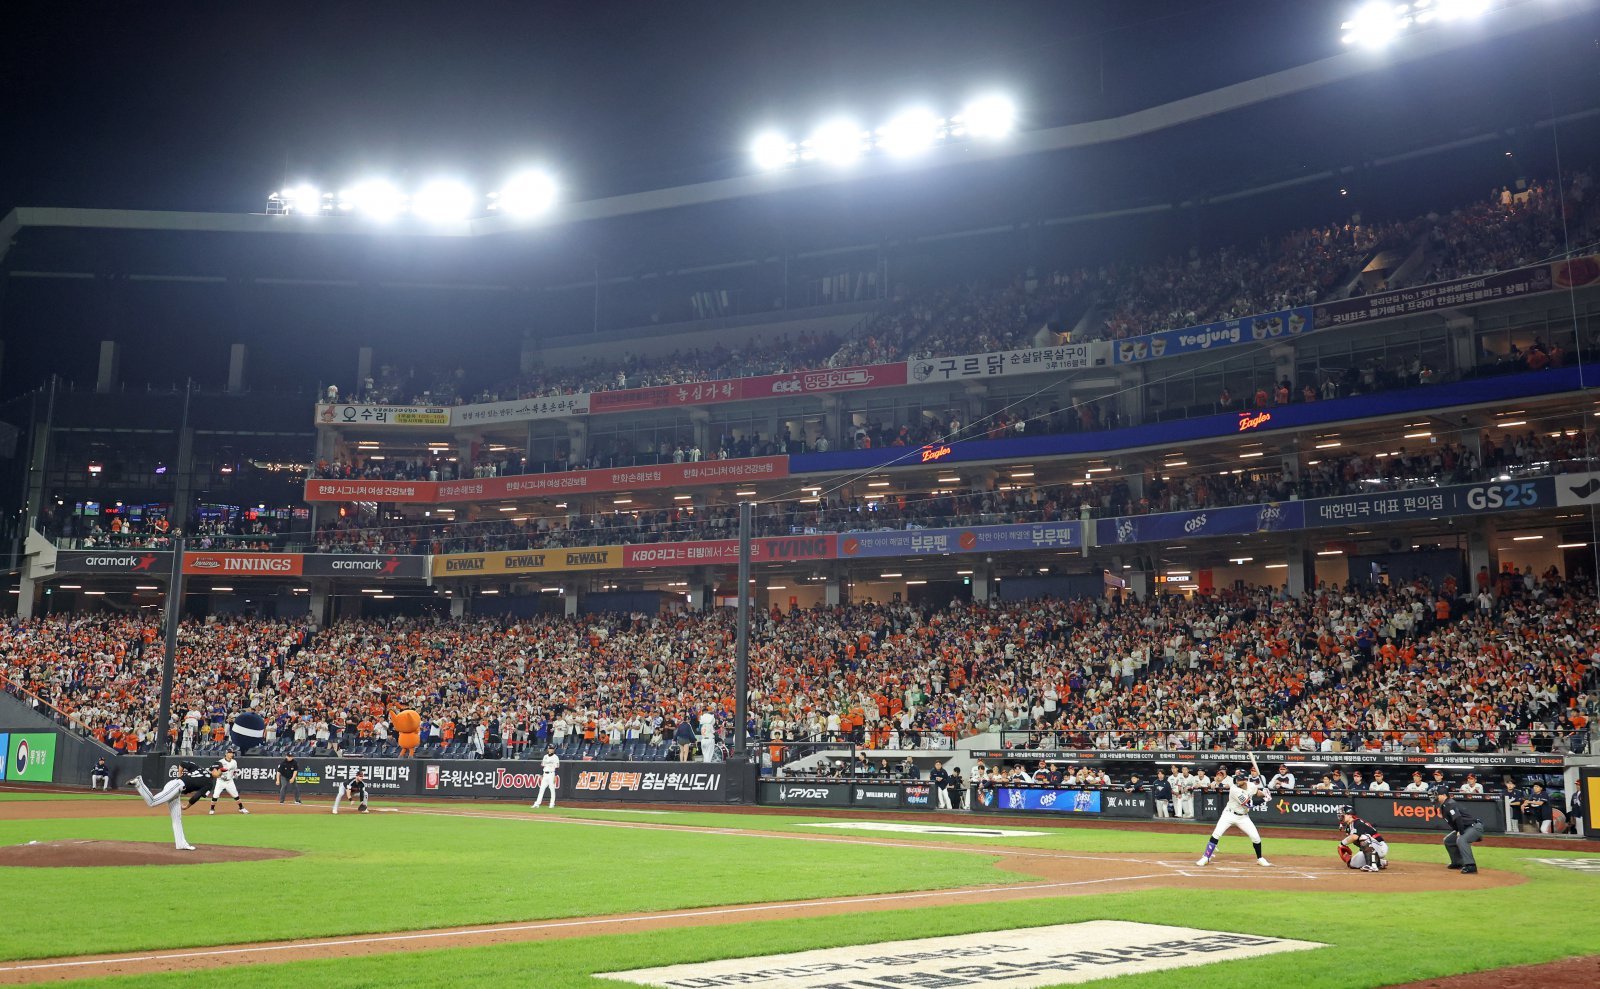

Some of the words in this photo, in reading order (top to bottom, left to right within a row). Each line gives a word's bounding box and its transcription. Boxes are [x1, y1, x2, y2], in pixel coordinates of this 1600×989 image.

[1010, 346, 1087, 365] 순살닭목살구이
[938, 353, 1005, 379] 구르닭
[676, 382, 735, 401] 농심가락
[342, 406, 387, 423] 오수리
[1239, 412, 1271, 431] Eagles
[922, 446, 951, 462] Eagles
[611, 471, 662, 484] 한화손해보험
[683, 468, 698, 478] 한화
[700, 466, 728, 477] 시그니처
[728, 465, 743, 475] 여성
[744, 463, 773, 474] 건강보험
[318, 486, 335, 495] 한화
[337, 486, 367, 495] 시그니처
[368, 486, 384, 495] 여성
[384, 487, 415, 496] 건강보험
[506, 481, 519, 491] 한화
[520, 479, 546, 490] 시그니처
[547, 478, 560, 488] 여성
[560, 477, 587, 487] 건강보험
[1320, 501, 1371, 519] 대한민국
[1374, 498, 1400, 515] 대표
[1403, 494, 1443, 513] 편의점
[1467, 483, 1538, 510] GS25
[874, 537, 888, 547] 아이
[911, 534, 947, 552] 부루펜
[993, 531, 1007, 541] 아이
[1032, 527, 1071, 547] 부루펜
[632, 549, 685, 562] KBO리그는
[687, 547, 722, 558] 티빙에서
[724, 543, 760, 557] 스트밍
[766, 538, 827, 558] TVING
[85, 555, 137, 567] aramark
[224, 558, 291, 571] INNINGS
[332, 558, 382, 570] aramark
[325, 765, 410, 781] 한국폴리텍대학
[440, 770, 496, 788] 주원산오리
[496, 767, 560, 789] Joow
[575, 771, 609, 790] 최강!
[609, 771, 642, 791] 행복!
[642, 772, 721, 791] 충남혁신도시
[788, 788, 829, 799] SPYDER
[884, 791, 897, 799] PLAY
[1117, 796, 1146, 807] ANEW
[1393, 801, 1443, 822] keep
